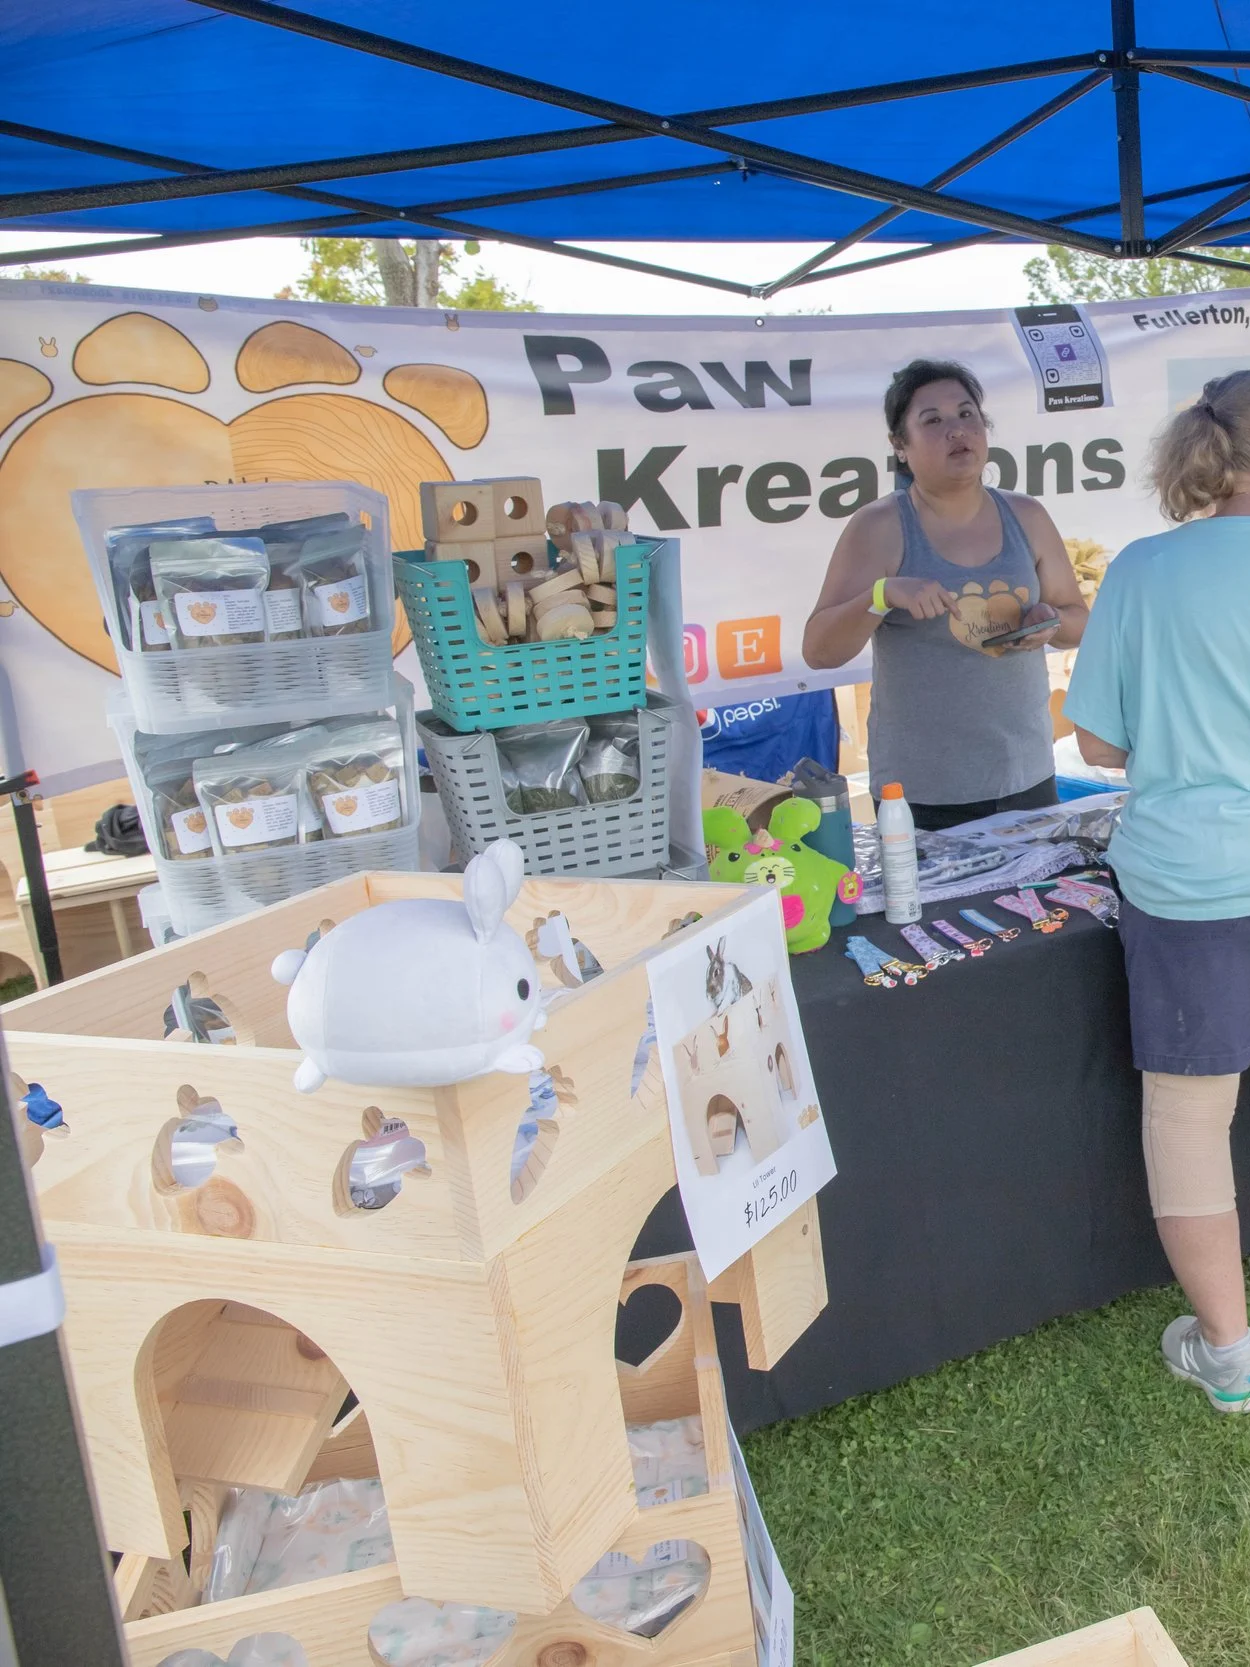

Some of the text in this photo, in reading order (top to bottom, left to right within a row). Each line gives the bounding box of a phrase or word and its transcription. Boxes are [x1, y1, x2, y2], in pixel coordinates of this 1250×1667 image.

[1132, 304, 1250, 331] Fullerton,
[523, 335, 812, 415] Paw
[597, 438, 1126, 531] Kreaons
[731, 628, 766, 668] E
[723, 697, 780, 727] pepsi
[759, 1166, 776, 1183] Tower
[744, 1169, 797, 1229] $125.00
